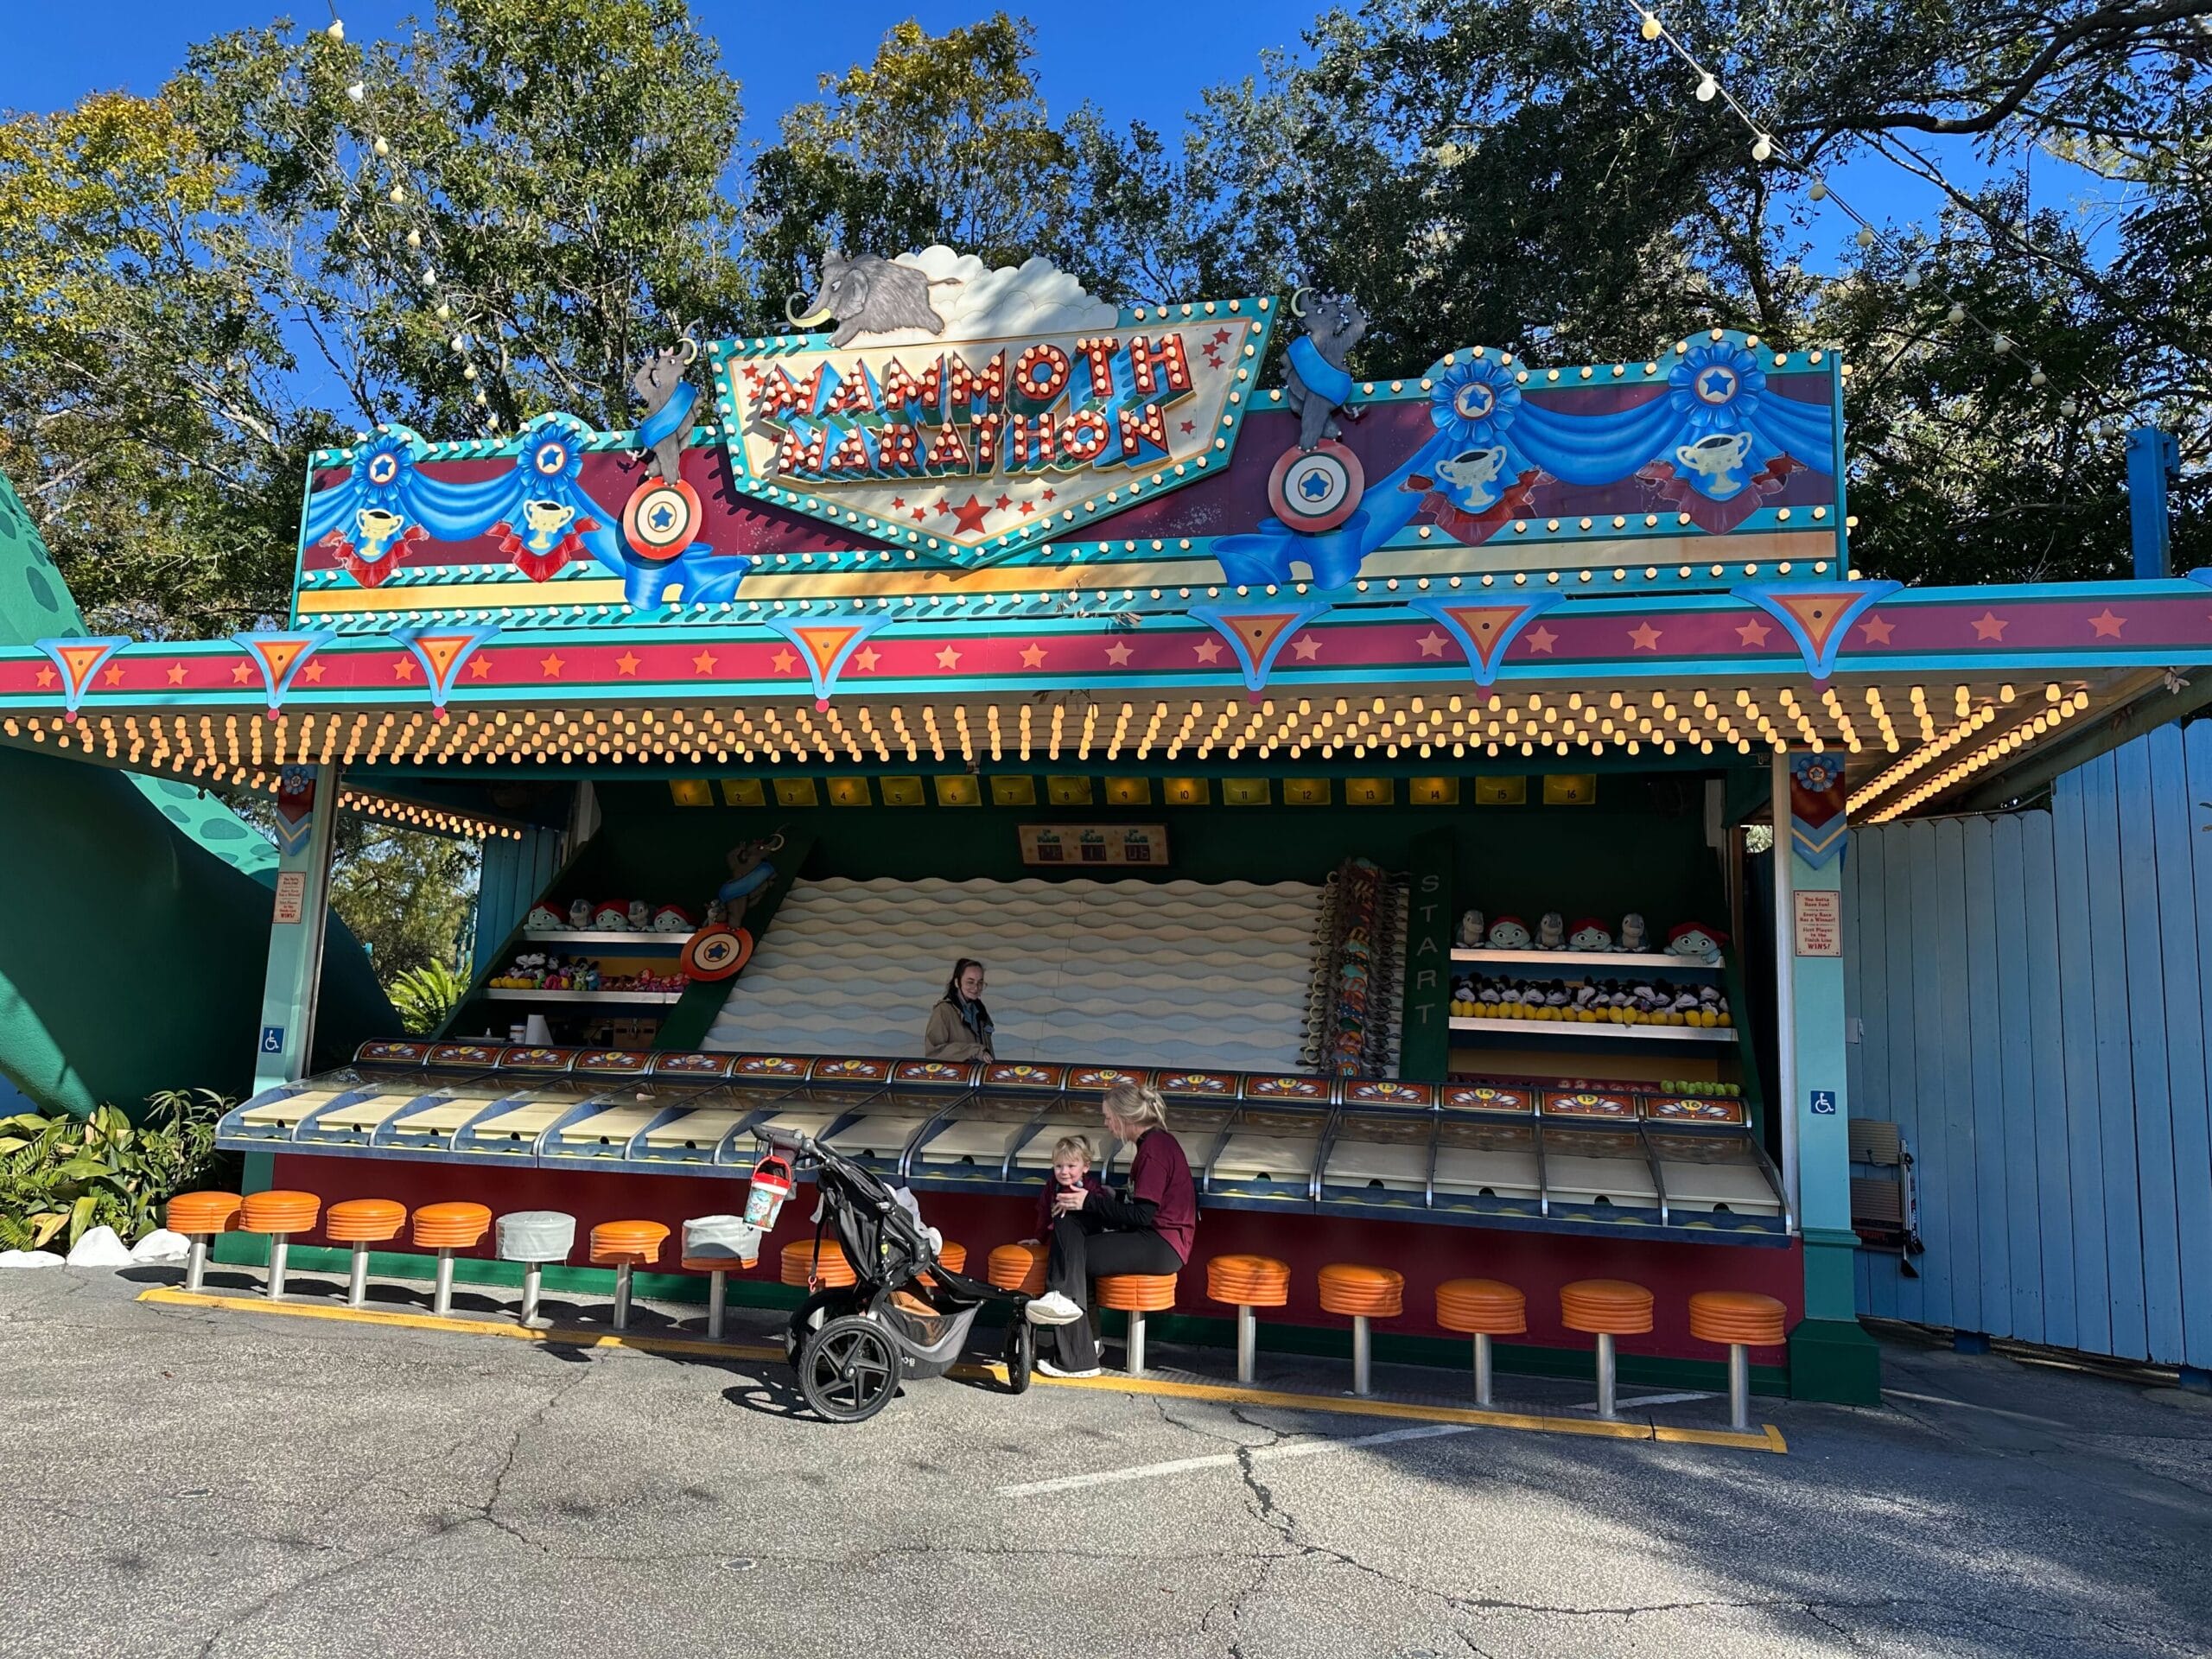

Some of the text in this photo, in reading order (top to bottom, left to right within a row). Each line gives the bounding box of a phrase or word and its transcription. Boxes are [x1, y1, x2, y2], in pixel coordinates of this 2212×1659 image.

[759, 332, 1193, 419] MAMMOTH
[777, 403, 1170, 474] MARATHON
[1414, 874, 1440, 1024] START
[1342, 1067, 1354, 1077] 16
